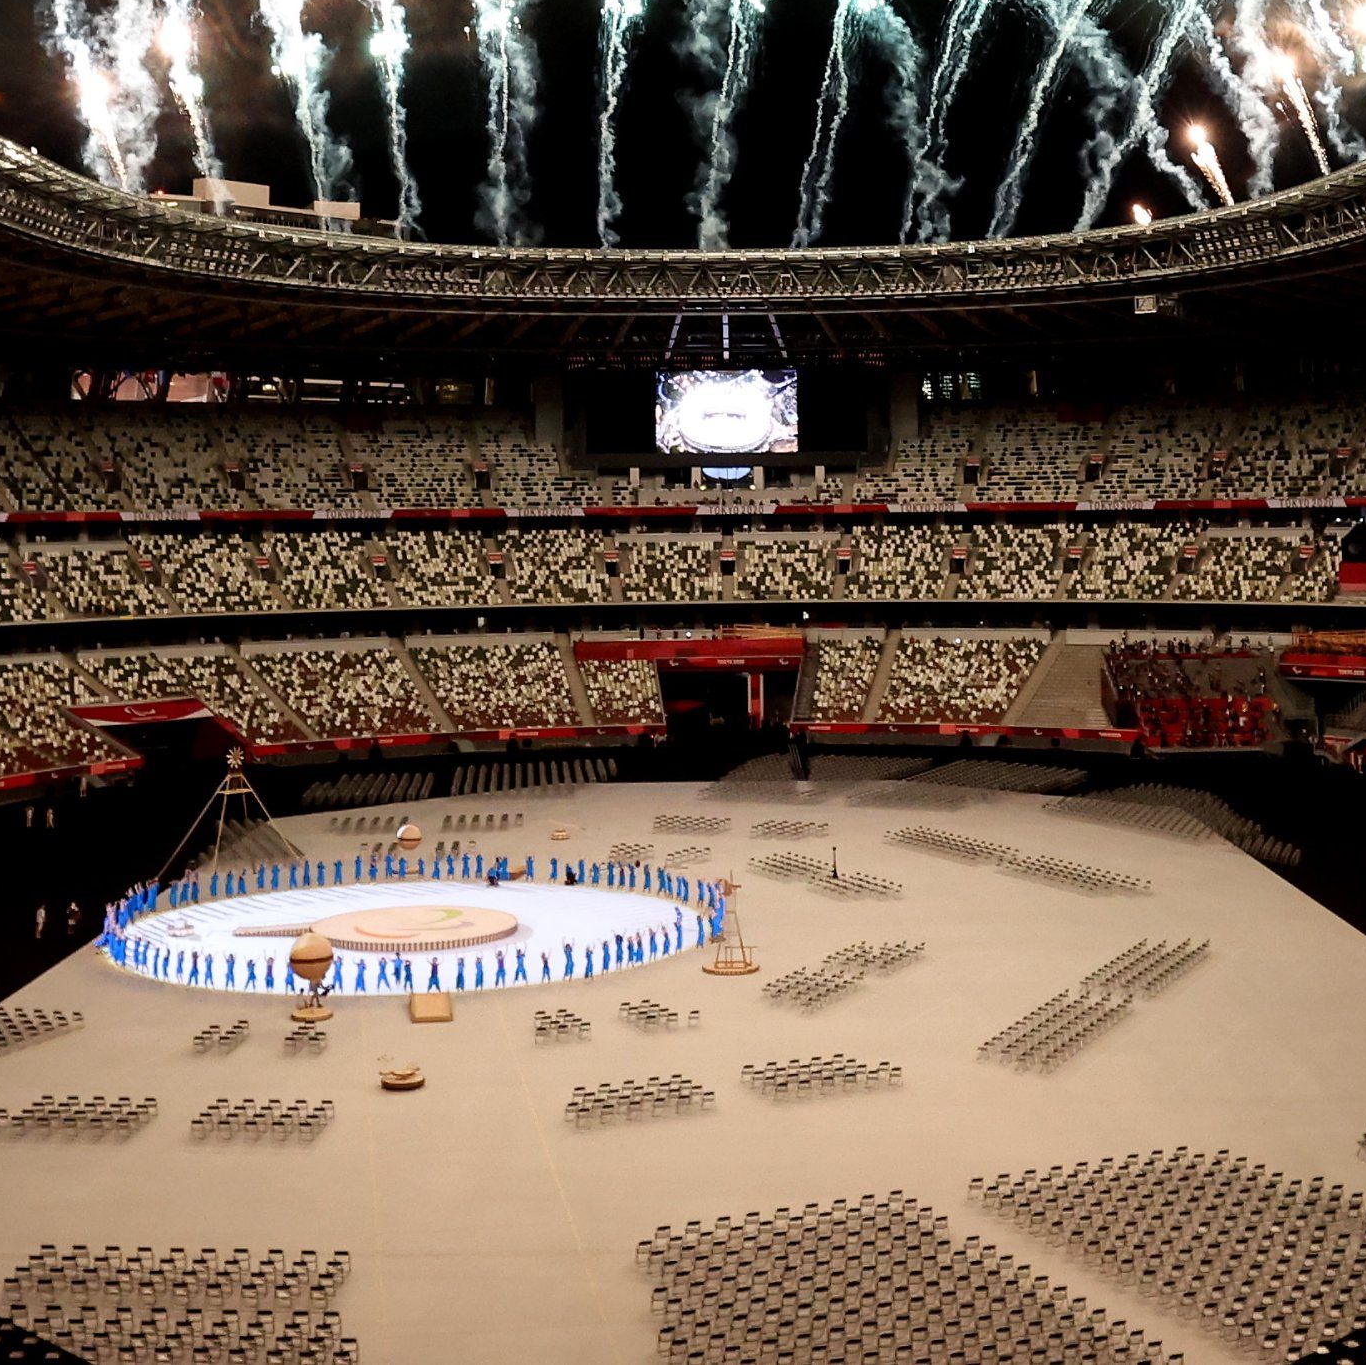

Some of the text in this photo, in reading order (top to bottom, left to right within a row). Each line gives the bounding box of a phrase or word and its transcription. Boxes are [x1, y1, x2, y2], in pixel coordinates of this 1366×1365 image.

[1280, 498, 1310, 507] TOKYO
[710, 505, 739, 514] TOKYO
[900, 503, 930, 512] TOKYO
